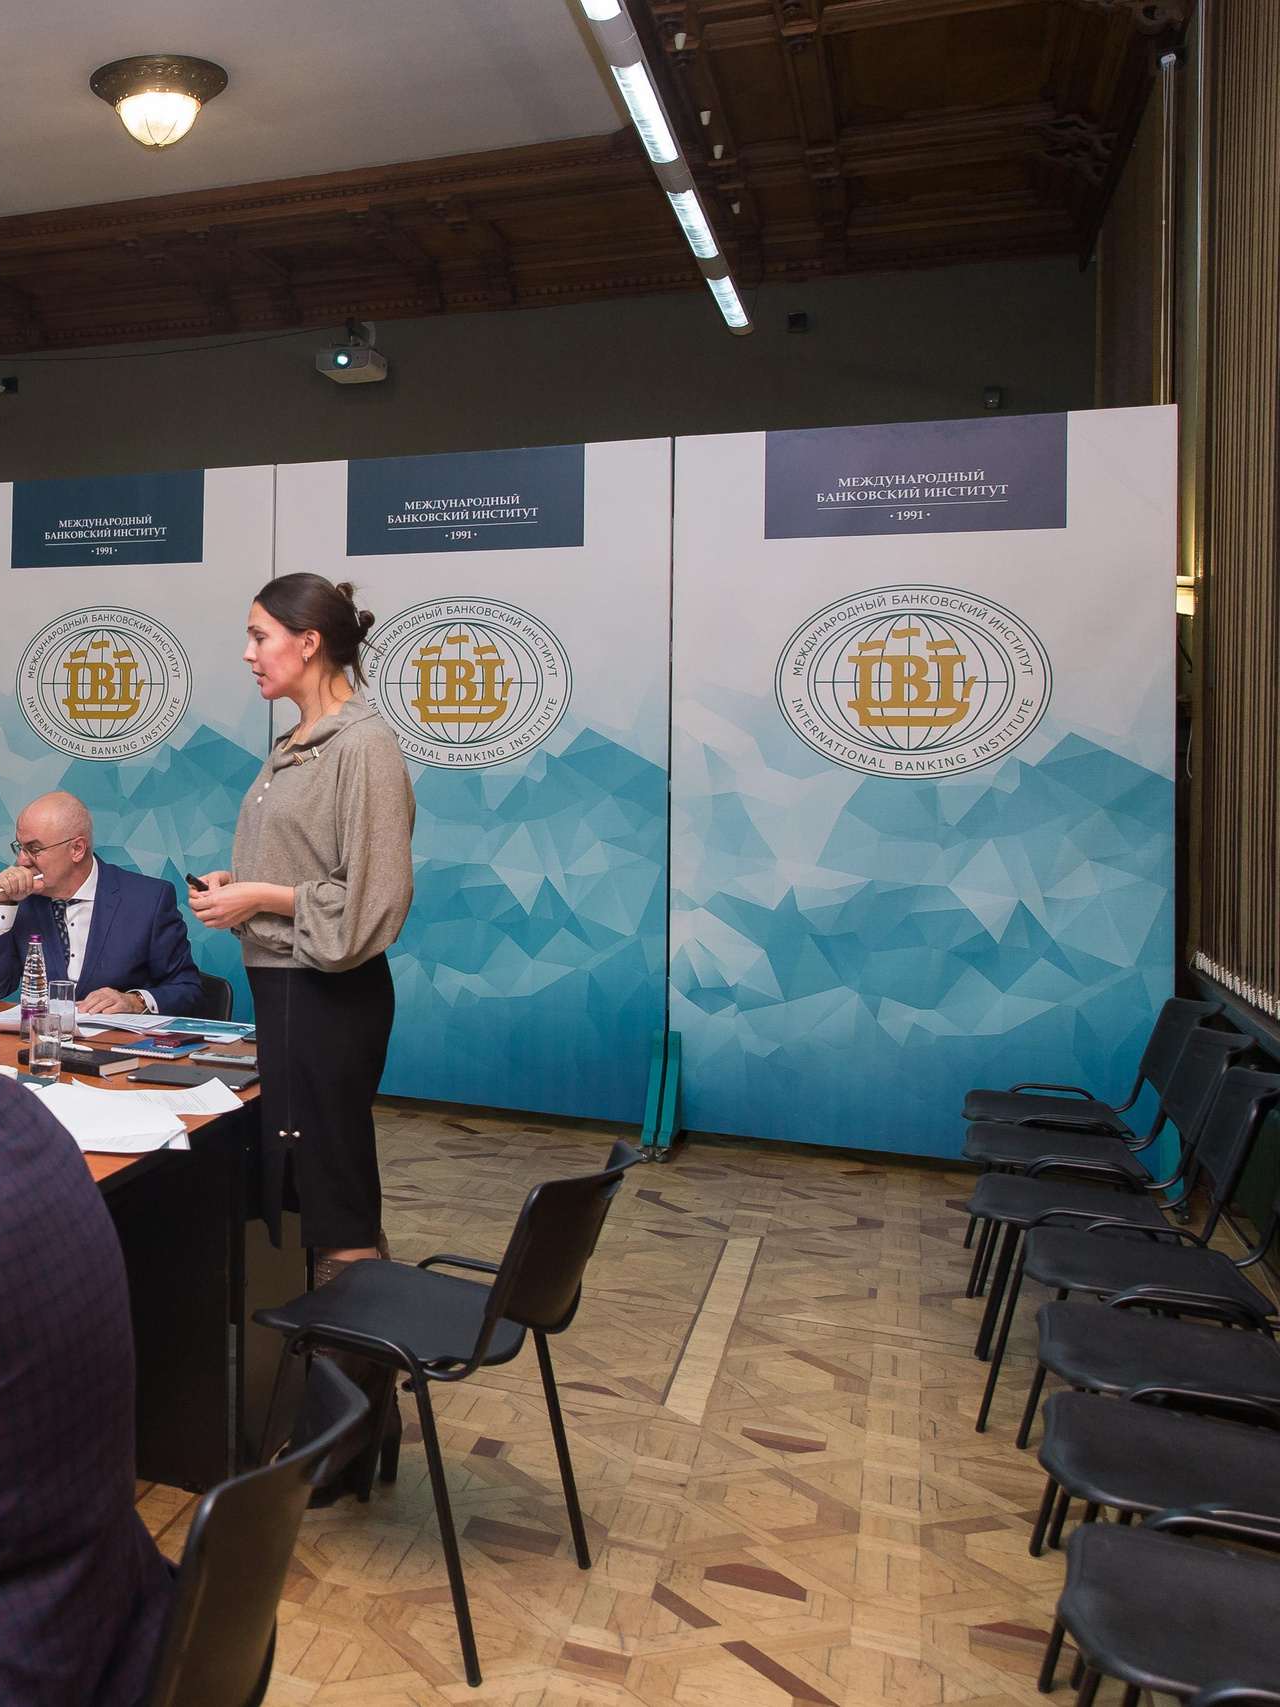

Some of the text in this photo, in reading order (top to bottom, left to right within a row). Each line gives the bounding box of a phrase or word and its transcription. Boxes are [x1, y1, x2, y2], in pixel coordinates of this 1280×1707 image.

[838, 469, 985, 488] МЕЖДУНАРОДНЫЙ
[404, 493, 520, 510] МЕЖДУНАРОДНЫЙ
[817, 484, 1009, 503] БАНКОВСКИЙ ИНСТИТУТ
[59, 514, 152, 529] МЕЖДУНАРОДНЫЙ
[387, 507, 539, 524] БАНКОВСКИЙ ИНСТИТУТ
[896, 511, 923, 521] 1991
[45, 527, 167, 540] БАНКОВСКИЙ ИНСТИТУТ
[450, 531, 471, 540] 1991
[95, 547, 113, 555] 1991
[368, 605, 558, 678] МЕЖДУНАРОДНЫЙ БАНКОВСКИЙ ИНСТИТУТ
[792, 595, 1033, 676] МЕЖДУНАРОДНЫЙ БАНКОВСКИЙ ИНСТИТУТ
[27, 613, 180, 679] МЕЖДУНАРОДНЫЙ БАНКОВСКИЙ ИНСТИТУТ
[26, 696, 180, 754] INTERNATIONAL BANKING INSTITUTE
[447, 746, 505, 762] BANKING
[509, 697, 558, 751] INSTITUTE
[791, 698, 1034, 771] INTERNATIONAL BANKING INSTITUTE
